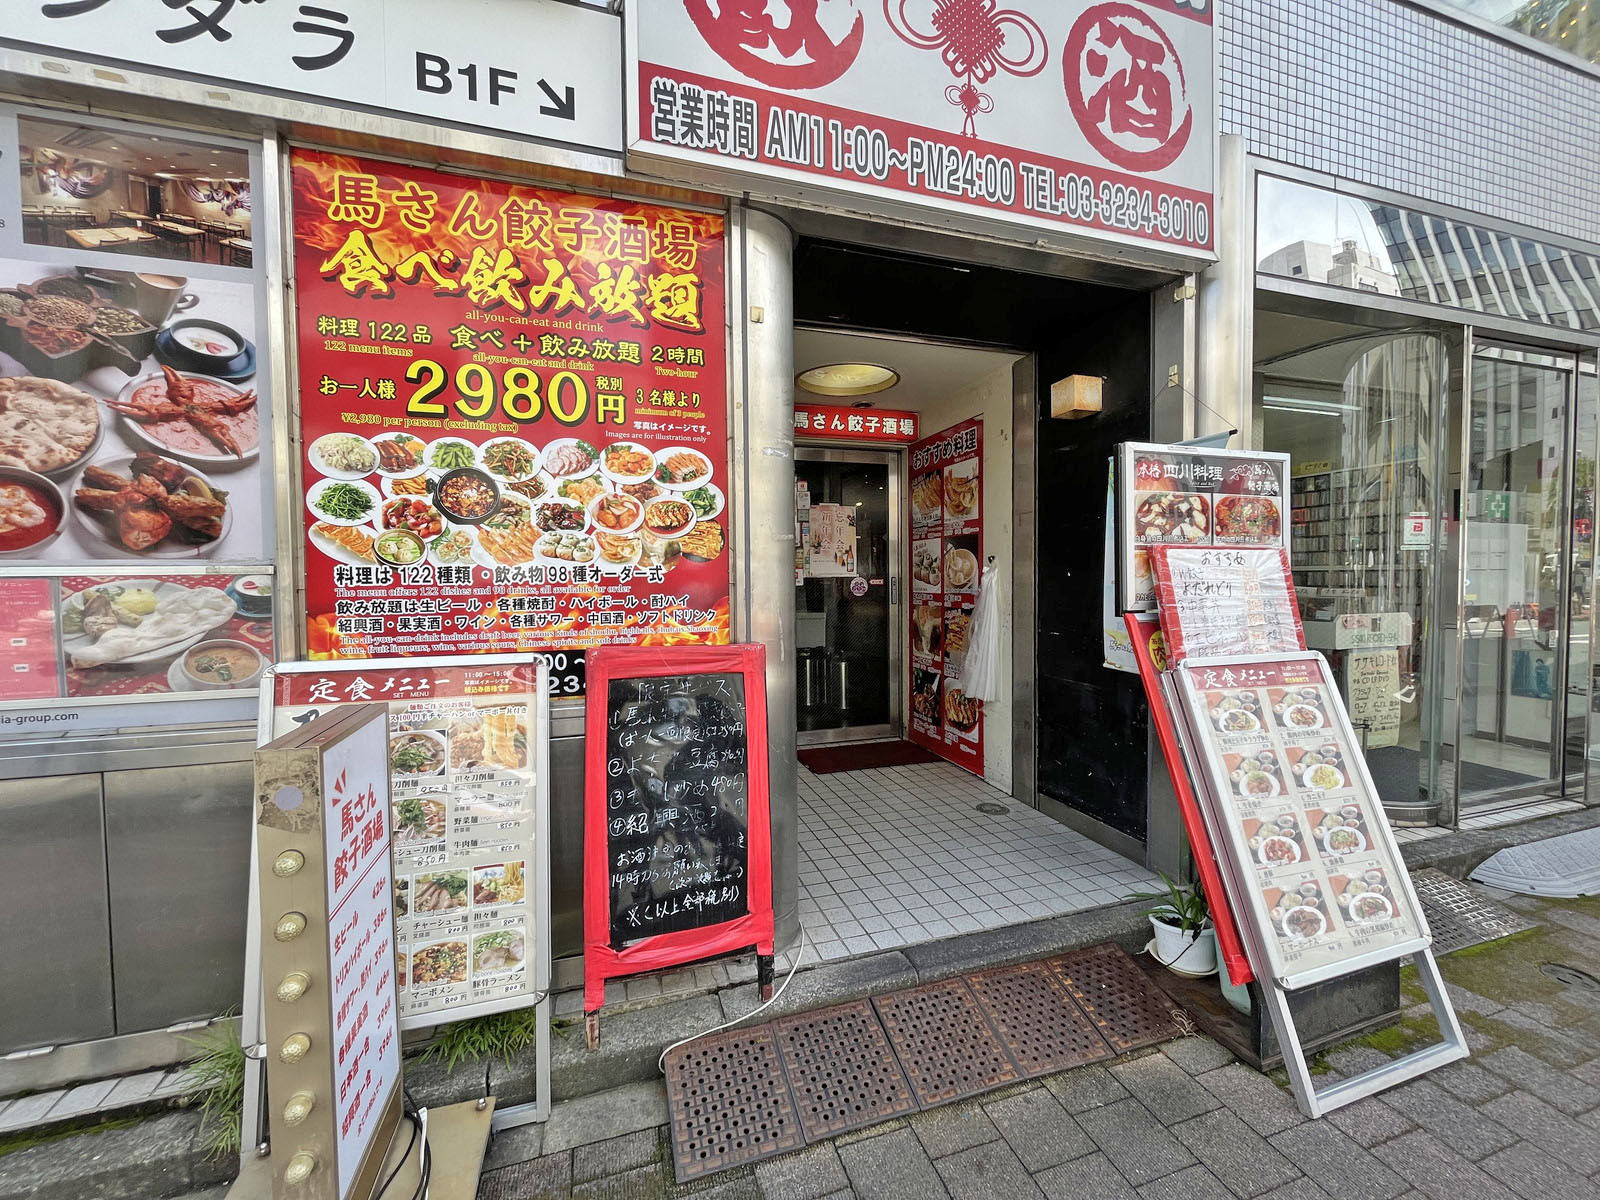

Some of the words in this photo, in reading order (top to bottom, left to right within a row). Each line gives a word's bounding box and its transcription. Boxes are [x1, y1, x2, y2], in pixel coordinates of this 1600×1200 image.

[416, 51, 518, 106] B1F
[651, 78, 757, 160] 営業時間
[1020, 164, 1209, 245] TEL:03-3234-3010
[327, 172, 702, 271] 馬さん餃子酒場
[318, 229, 706, 333] 食べ飲み放題
[465, 309, 550, 328] all-you-can-eat
[552, 319, 573, 330] and
[574, 321, 604, 333] drink
[317, 314, 361, 338] 料理
[368, 321, 408, 342] 122
[411, 324, 433, 344] 品
[449, 323, 506, 350] 食べ
[538, 333, 643, 366] 飲み放題
[323, 339, 347, 352] 122
[348, 344, 381, 353] menu
[382, 345, 414, 357] items
[548, 358, 567, 369] and
[568, 359, 595, 372] drink
[655, 366, 698, 379] Two-hour
[318, 374, 398, 401] お一人様
[404, 358, 591, 428] 2980
[594, 375, 624, 392] 税別
[383, 415, 403, 427] per
[404, 416, 442, 429] person
[444, 418, 497, 432] (excluding
[633, 420, 712, 436] 写真はイメージです。
[794, 410, 916, 437] 馬さん餃子酒場
[605, 430, 631, 440] Images
[631, 432, 643, 440] are
[644, 432, 654, 440] for
[655, 432, 691, 442] illustration
[912, 426, 978, 470] おすすめ料理
[1201, 552, 1247, 566] おすすめ
[334, 587, 356, 598] The
[357, 587, 388, 598] menu
[388, 587, 419, 597] offers
[419, 586, 439, 597] 122
[440, 586, 472, 596] dishes
[473, 585, 492, 596] and
[540, 584, 552, 594] all
[553, 584, 593, 594] available
[593, 584, 606, 593] for
[607, 584, 631, 593] order
[1182, 581, 1232, 598] よだれどり
[339, 635, 359, 645] The
[440, 632, 478, 642] includes
[1203, 667, 1276, 689] 定食メニュー
[308, 675, 452, 703] 定食メニュー
[410, 690, 430, 698] MENU
[341, 783, 377, 842] 馬さん
[453, 815, 479, 826] 野菜麺
[334, 809, 384, 893] 餃子酒場
[454, 838, 479, 849] 牛肉麺
[412, 915, 469, 931] チャーシュー麺
[333, 910, 359, 957] 生ビール
